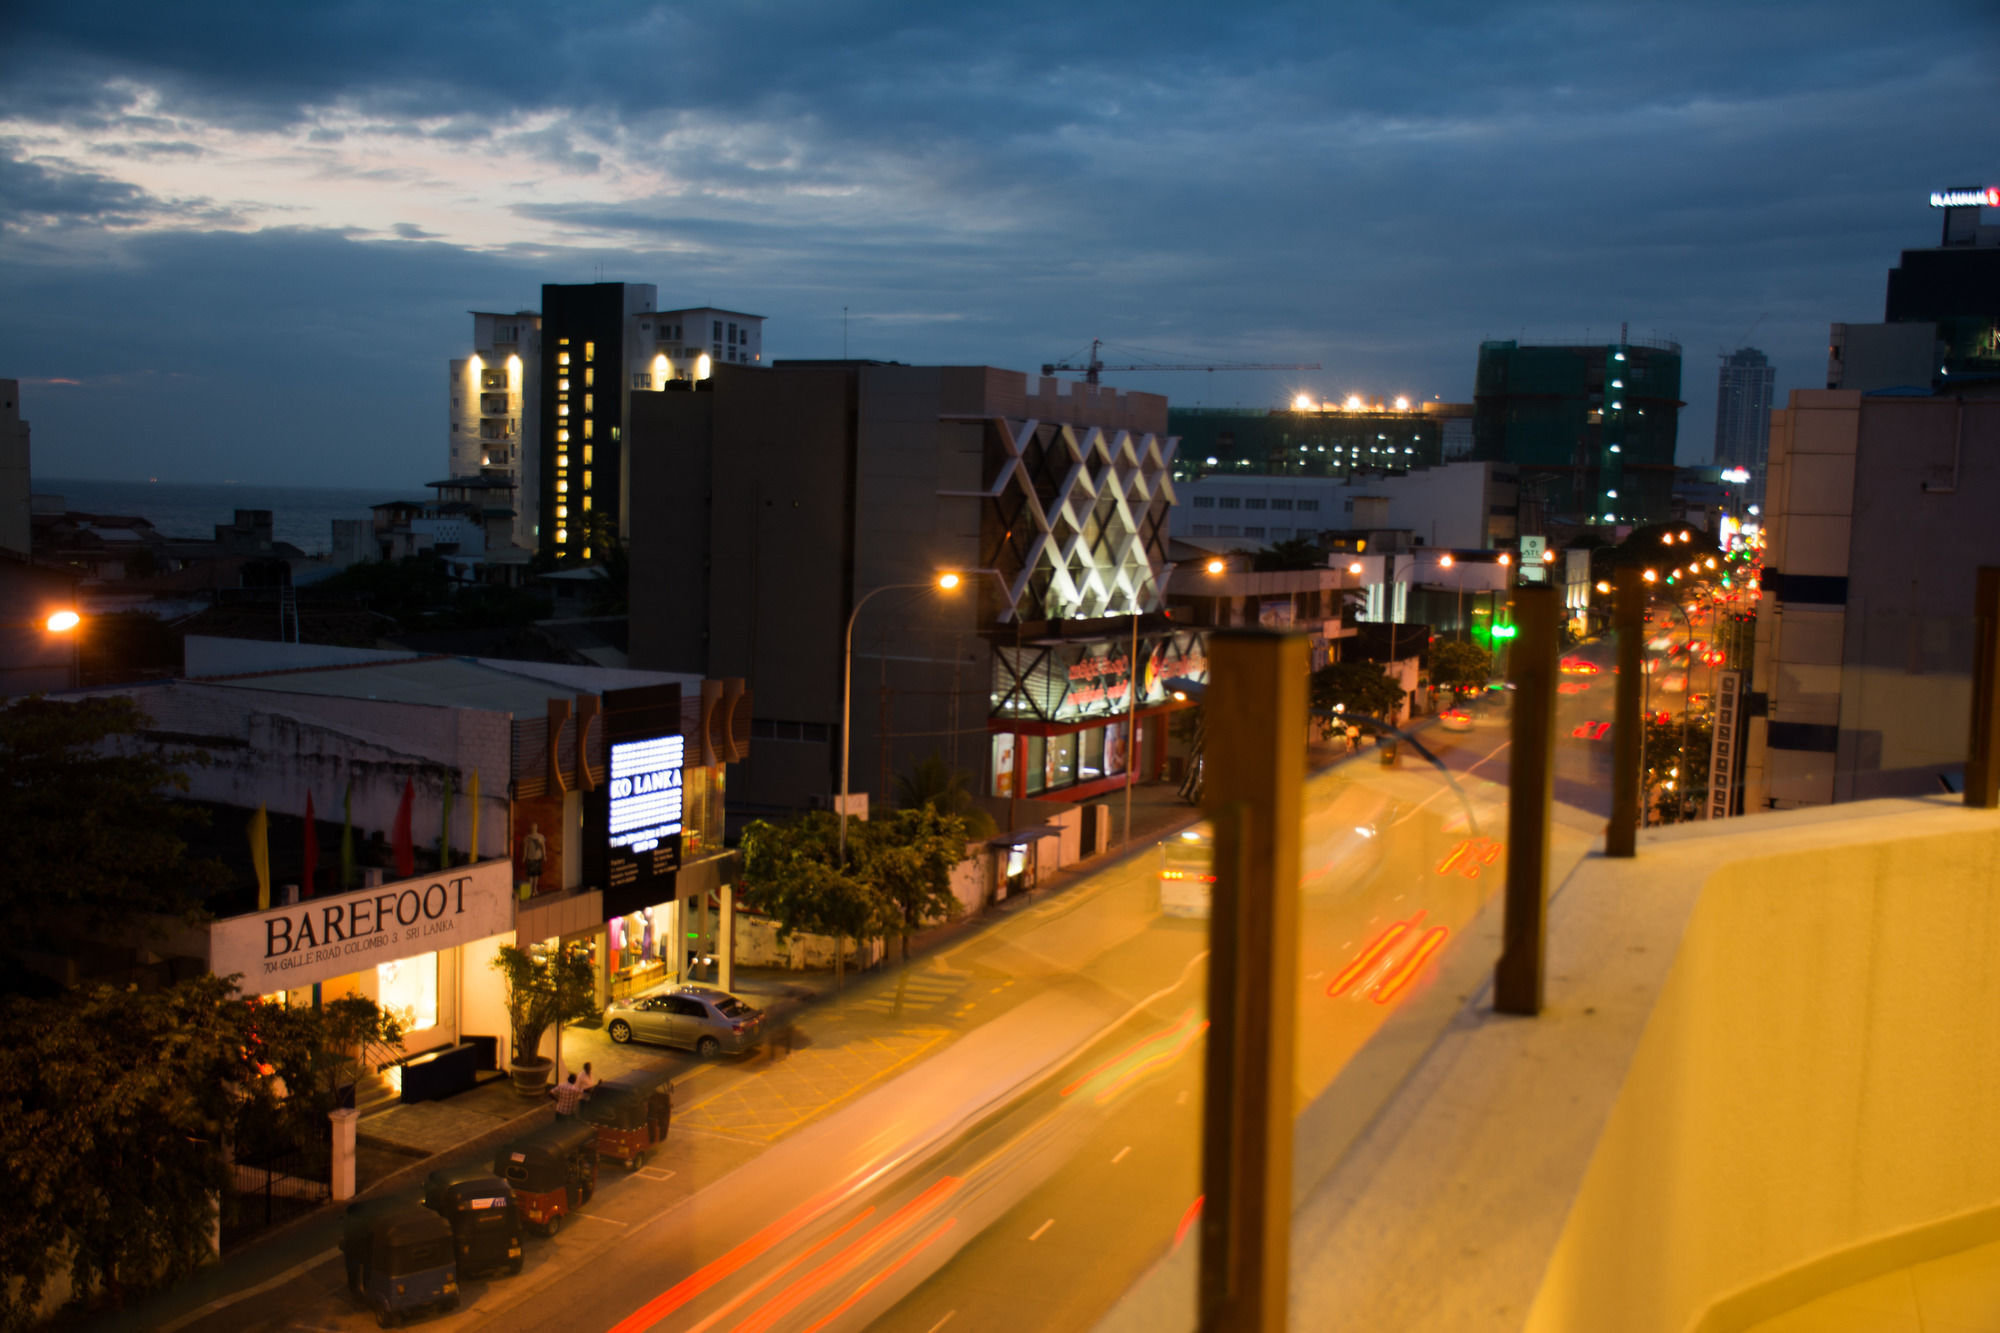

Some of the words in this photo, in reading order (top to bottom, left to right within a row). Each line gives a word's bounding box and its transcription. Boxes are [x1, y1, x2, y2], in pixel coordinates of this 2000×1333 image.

[634, 769, 682, 794] LANKA
[264, 876, 473, 959] BAREFOOT
[264, 962, 278, 974] 704
[280, 952, 314, 971] GALLE
[315, 948, 341, 962] ROAD
[344, 935, 390, 956] COLOMBO
[391, 934, 398, 944] 3
[406, 928, 420, 941] SRI
[423, 920, 455, 936] LANKA
